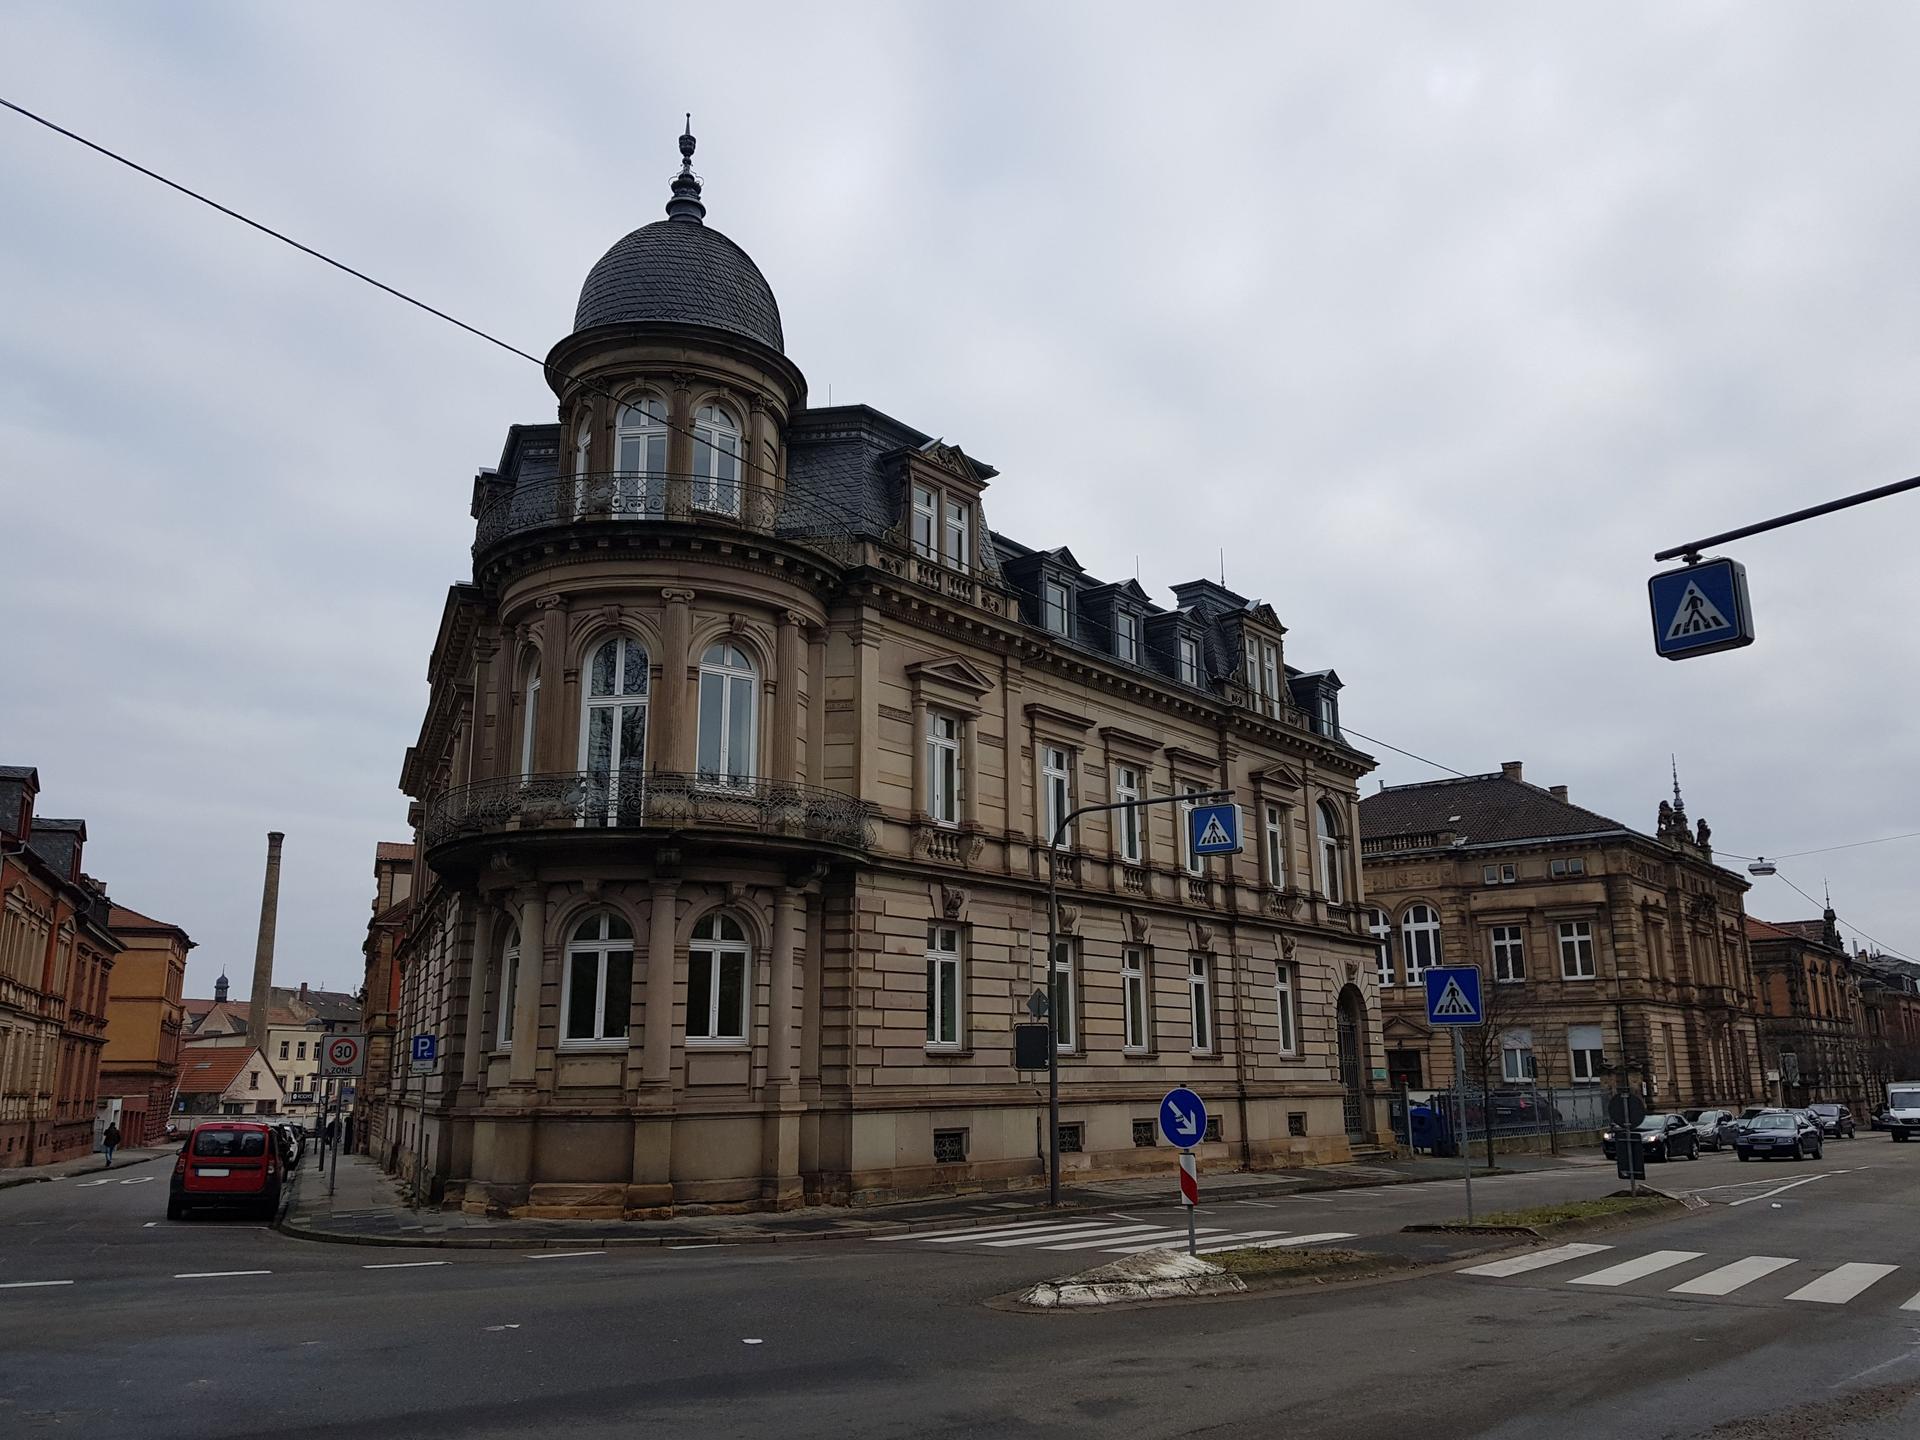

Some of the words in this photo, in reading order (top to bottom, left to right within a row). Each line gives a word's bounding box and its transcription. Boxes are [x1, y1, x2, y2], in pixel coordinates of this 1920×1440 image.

[335, 1045, 352, 1058] 30
[417, 1038, 430, 1057] P
[331, 1066, 353, 1074] ZONE
